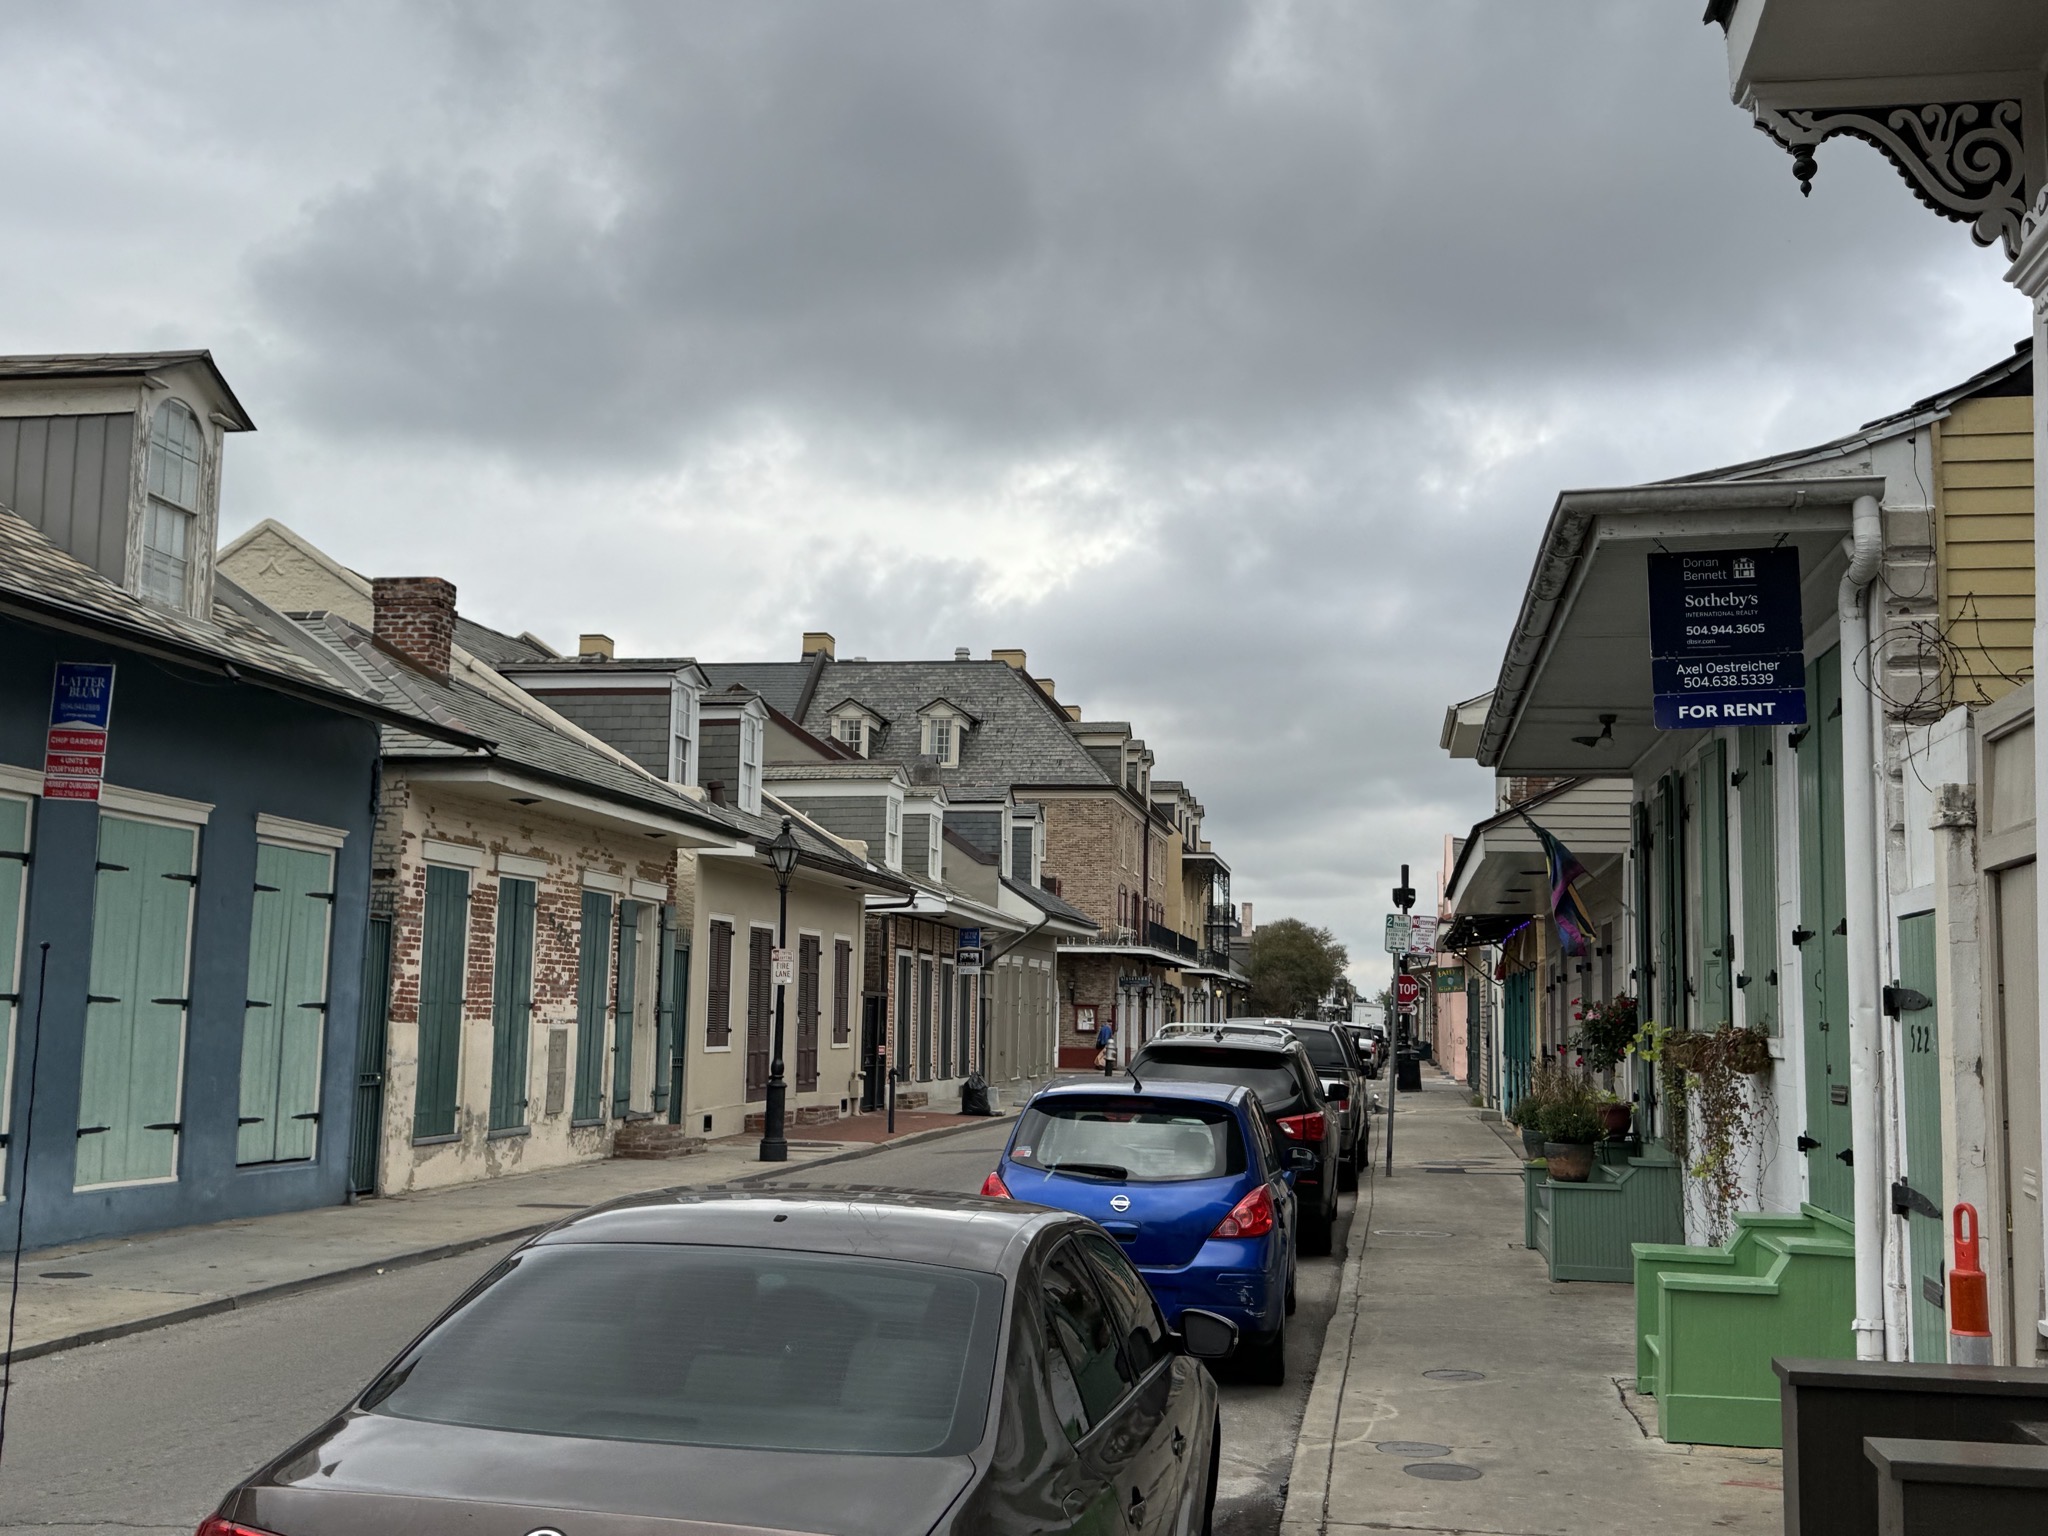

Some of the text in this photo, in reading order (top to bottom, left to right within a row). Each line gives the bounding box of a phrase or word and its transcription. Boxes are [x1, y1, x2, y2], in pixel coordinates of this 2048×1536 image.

[1683, 558, 1719, 568] Dorian
[1683, 570, 1728, 581] Bennett
[1684, 592, 1758, 608] Sotheby's
[1685, 610, 1735, 618] INTERNATIONAL
[1686, 623, 1765, 636] 504.944.3605
[1676, 660, 1780, 675] Axel Oestreicher
[60, 675, 105, 688] LATTER
[1684, 673, 1774, 688] 504.638.5339
[69, 686, 100, 698] BLUM
[1678, 702, 1776, 719] FOR RENT
[50, 736, 104, 746] CHIP GARDNER
[84, 767, 100, 775] POOL
[1387, 916, 1393, 927] 2
[776, 962, 790, 970] FIRE
[775, 970, 791, 978] LANE
[1398, 983, 1418, 995] TOP
[1911, 1024, 1930, 1054] 522
